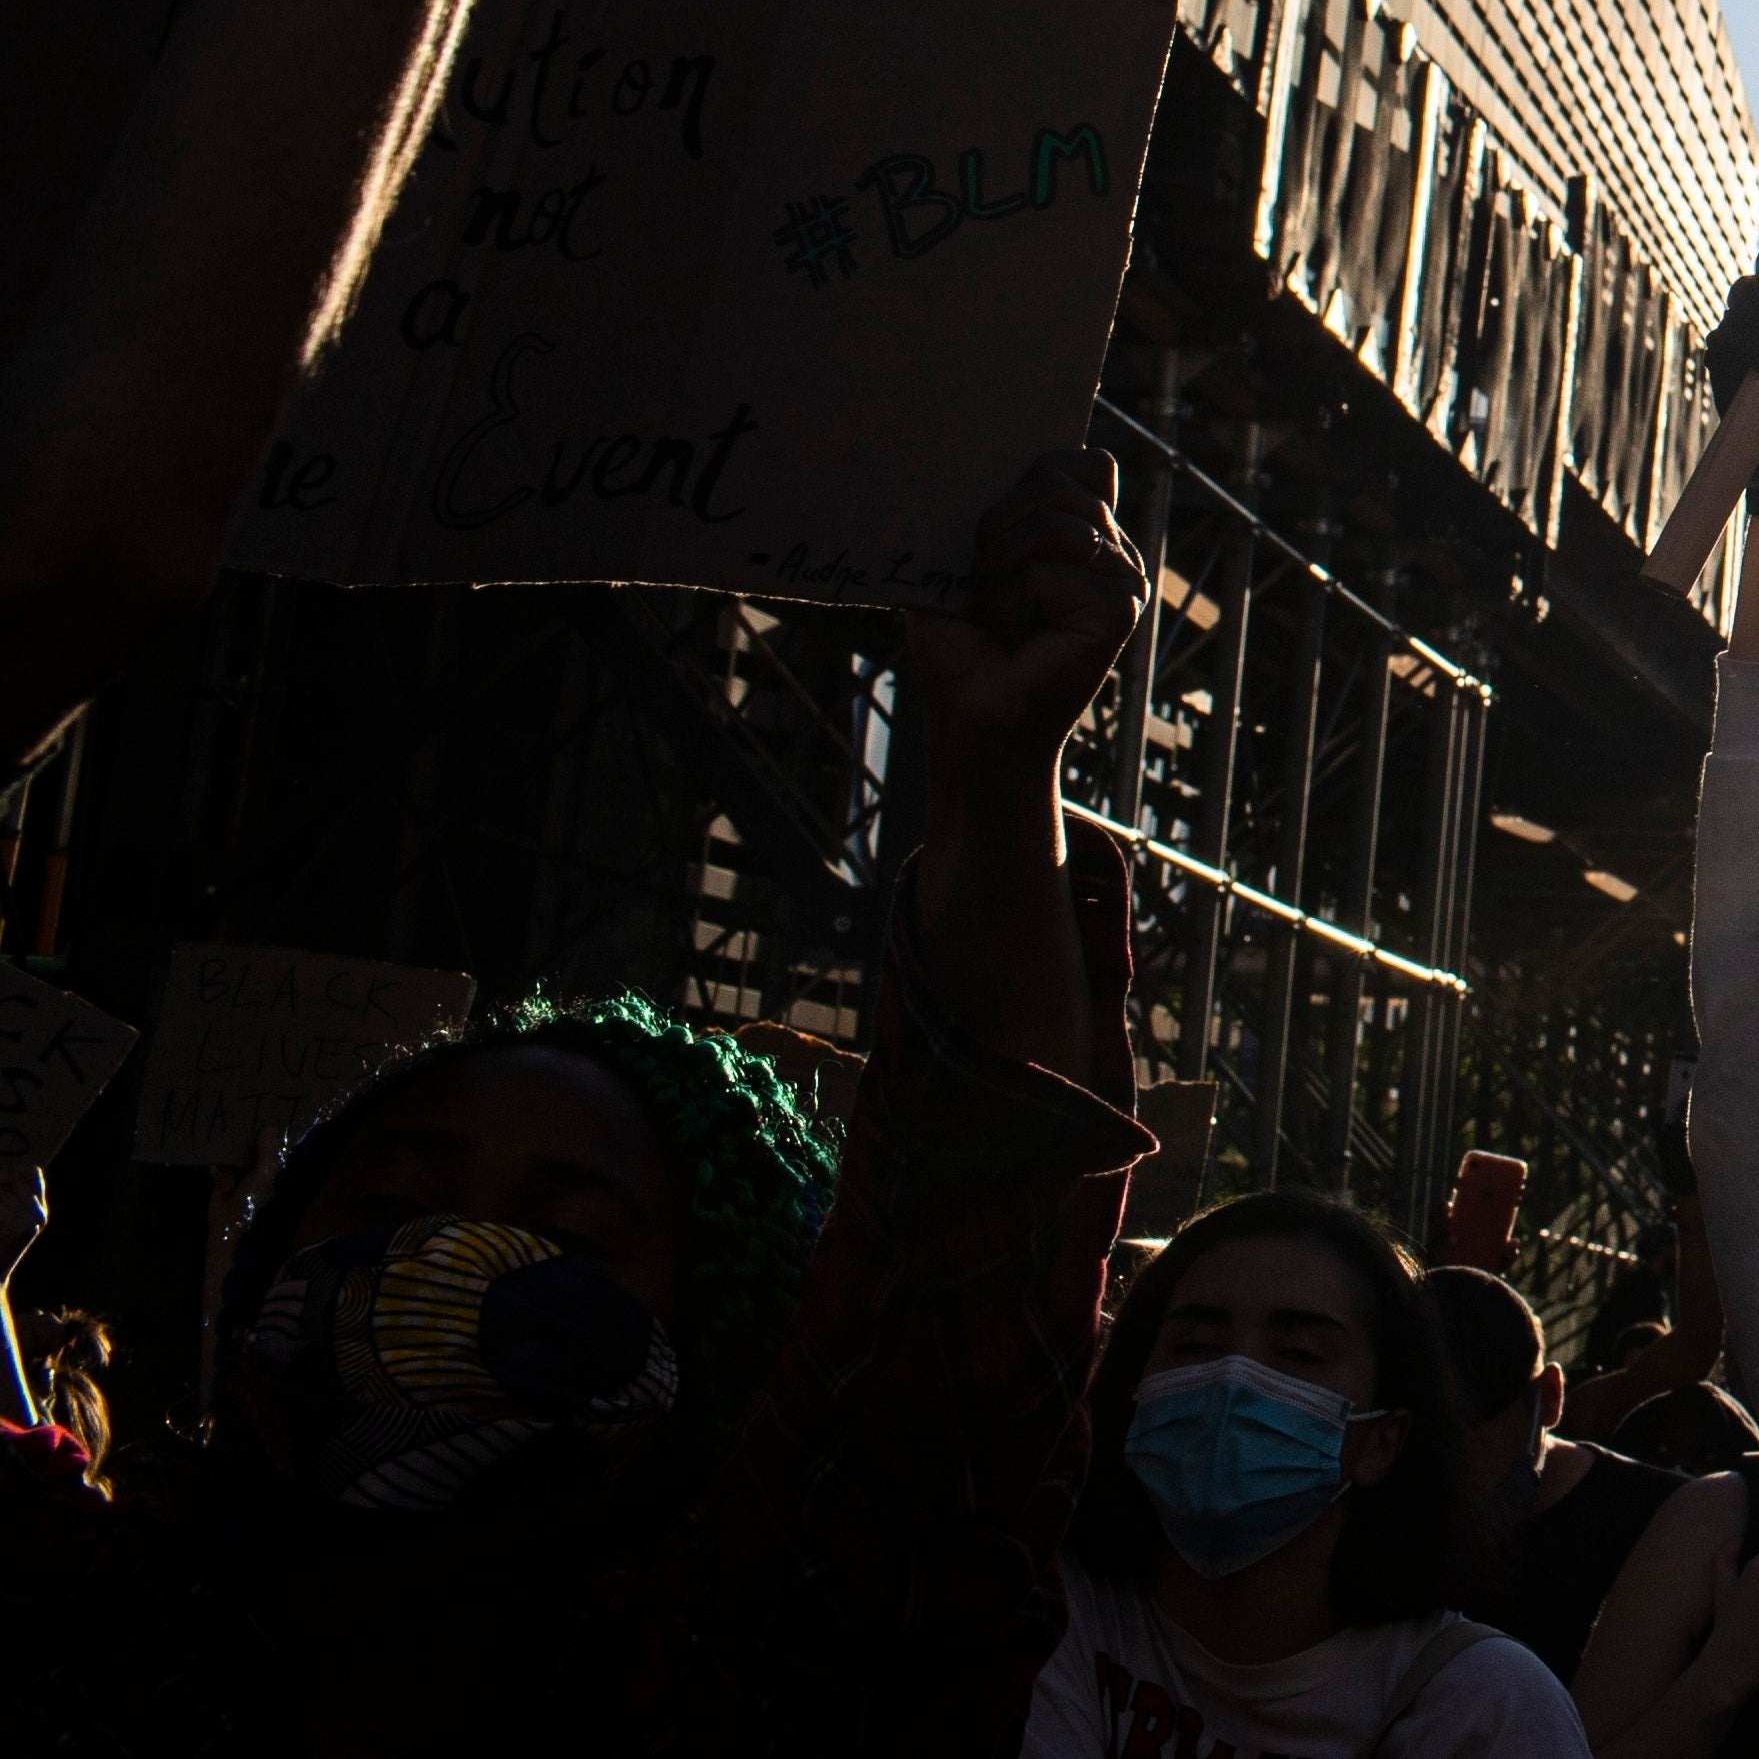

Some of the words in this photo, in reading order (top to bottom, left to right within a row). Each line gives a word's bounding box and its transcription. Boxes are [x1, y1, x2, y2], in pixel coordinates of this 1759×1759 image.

[431, 9, 715, 160] ution
[460, 167, 606, 264] not
[771, 122, 1109, 289] #BLM
[398, 279, 466, 350] a
[431, 330, 760, 531] Event
[199, 957, 403, 1029] BLACK
[195, 1024, 382, 1081] LIVES
[158, 1089, 308, 1150] MATT
